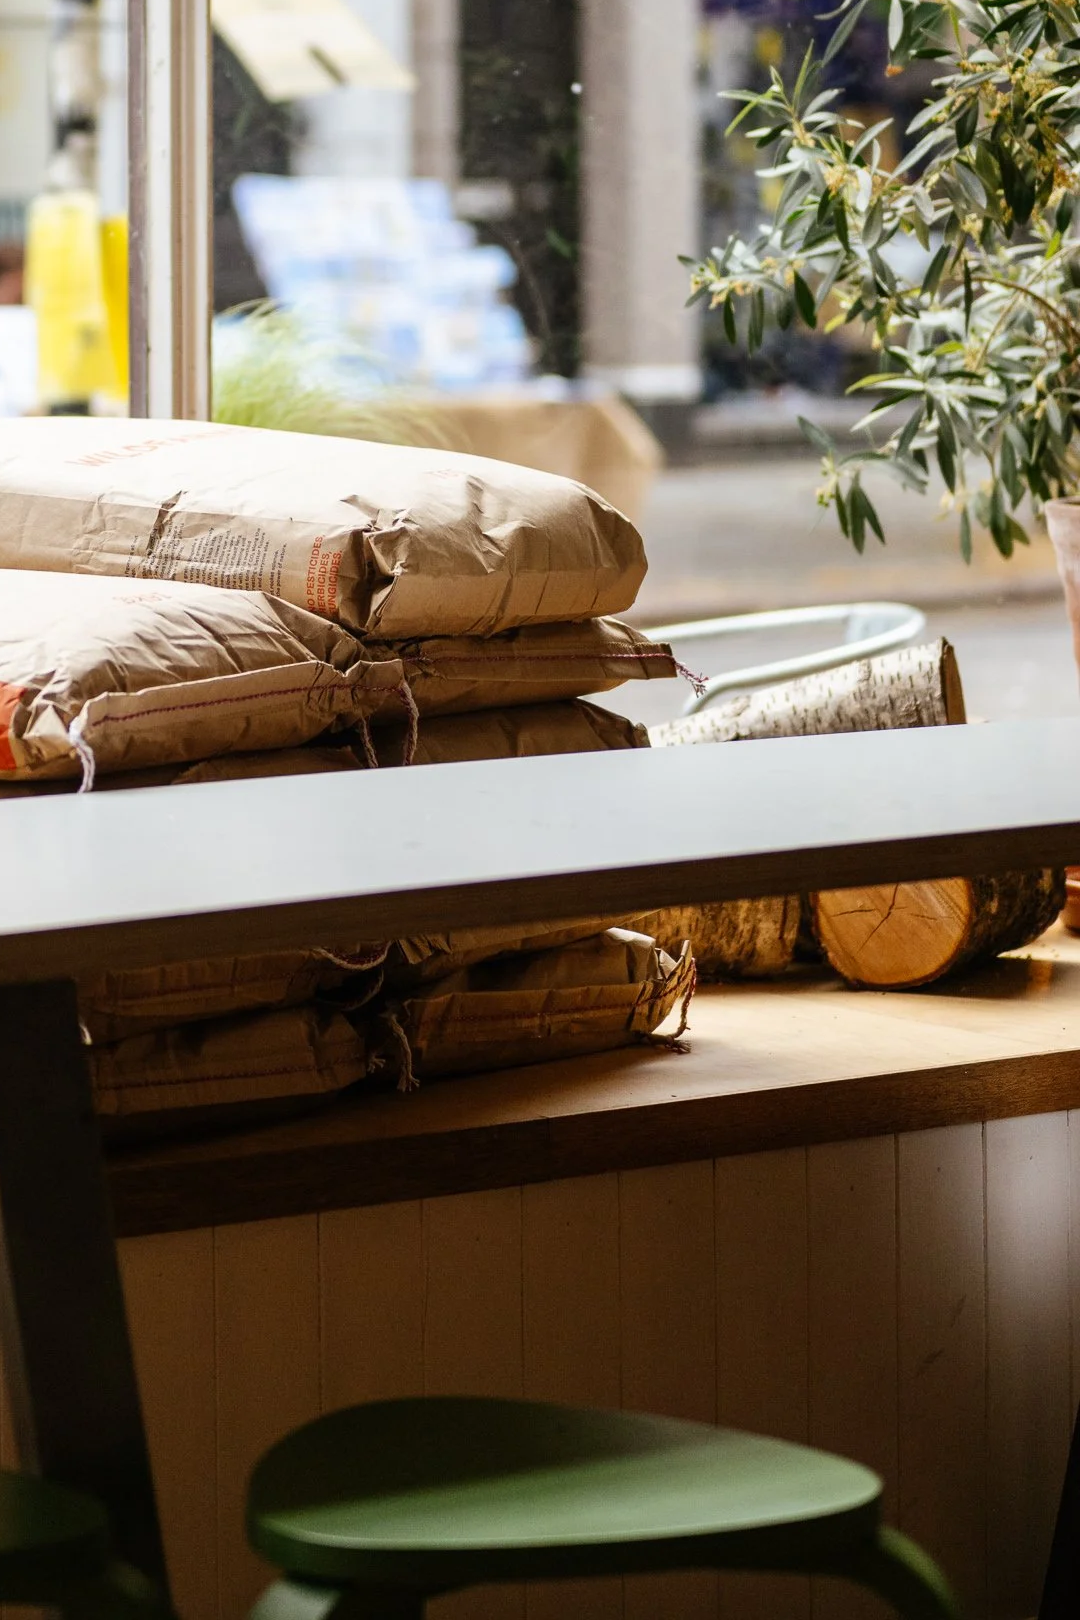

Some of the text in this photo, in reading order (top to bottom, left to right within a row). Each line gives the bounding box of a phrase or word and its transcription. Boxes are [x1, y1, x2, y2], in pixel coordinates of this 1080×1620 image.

[306, 535, 325, 612] NO PESTICIDES,
[317, 552, 332, 614] HERBICIDES,
